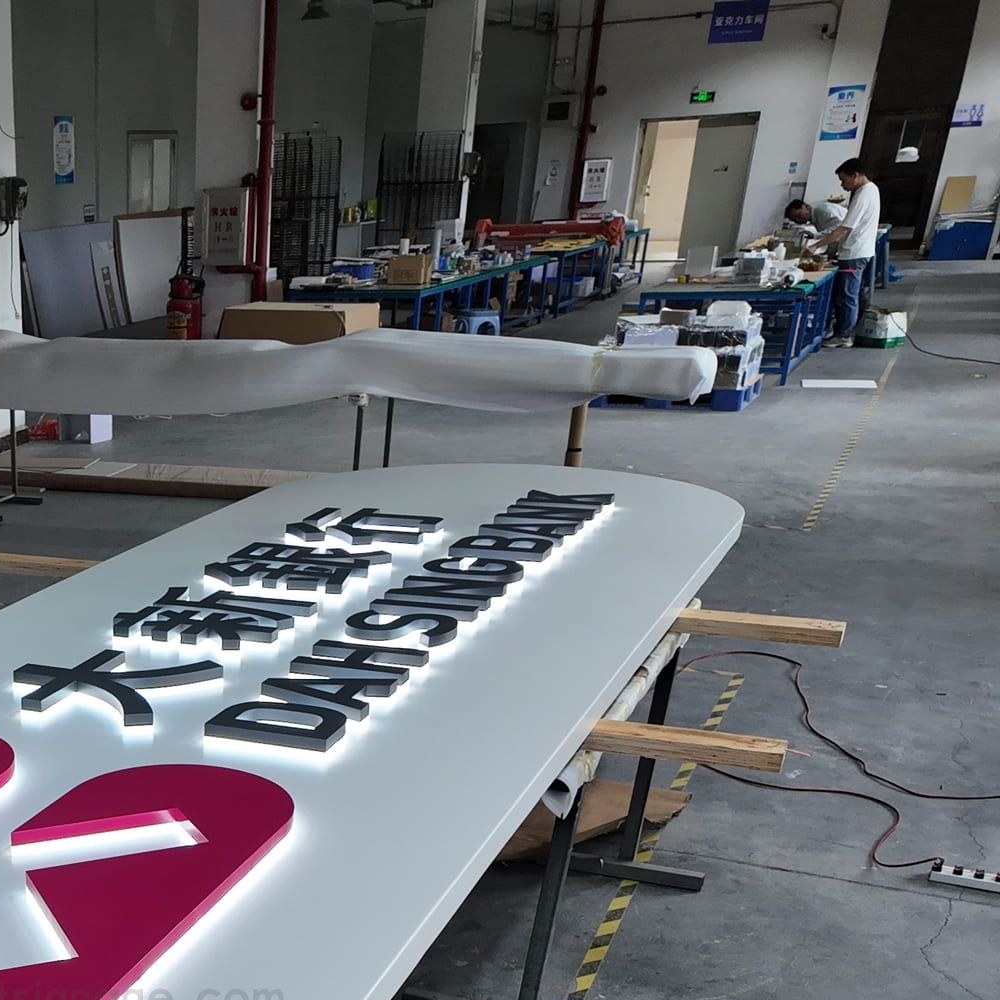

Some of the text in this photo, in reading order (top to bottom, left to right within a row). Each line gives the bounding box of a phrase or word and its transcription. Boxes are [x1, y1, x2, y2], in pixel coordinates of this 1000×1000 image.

[713, 14, 765, 26] 亚克力车间
[12, 506, 445, 728] 大新銀行
[203, 488, 616, 753] DAH SING BANK
